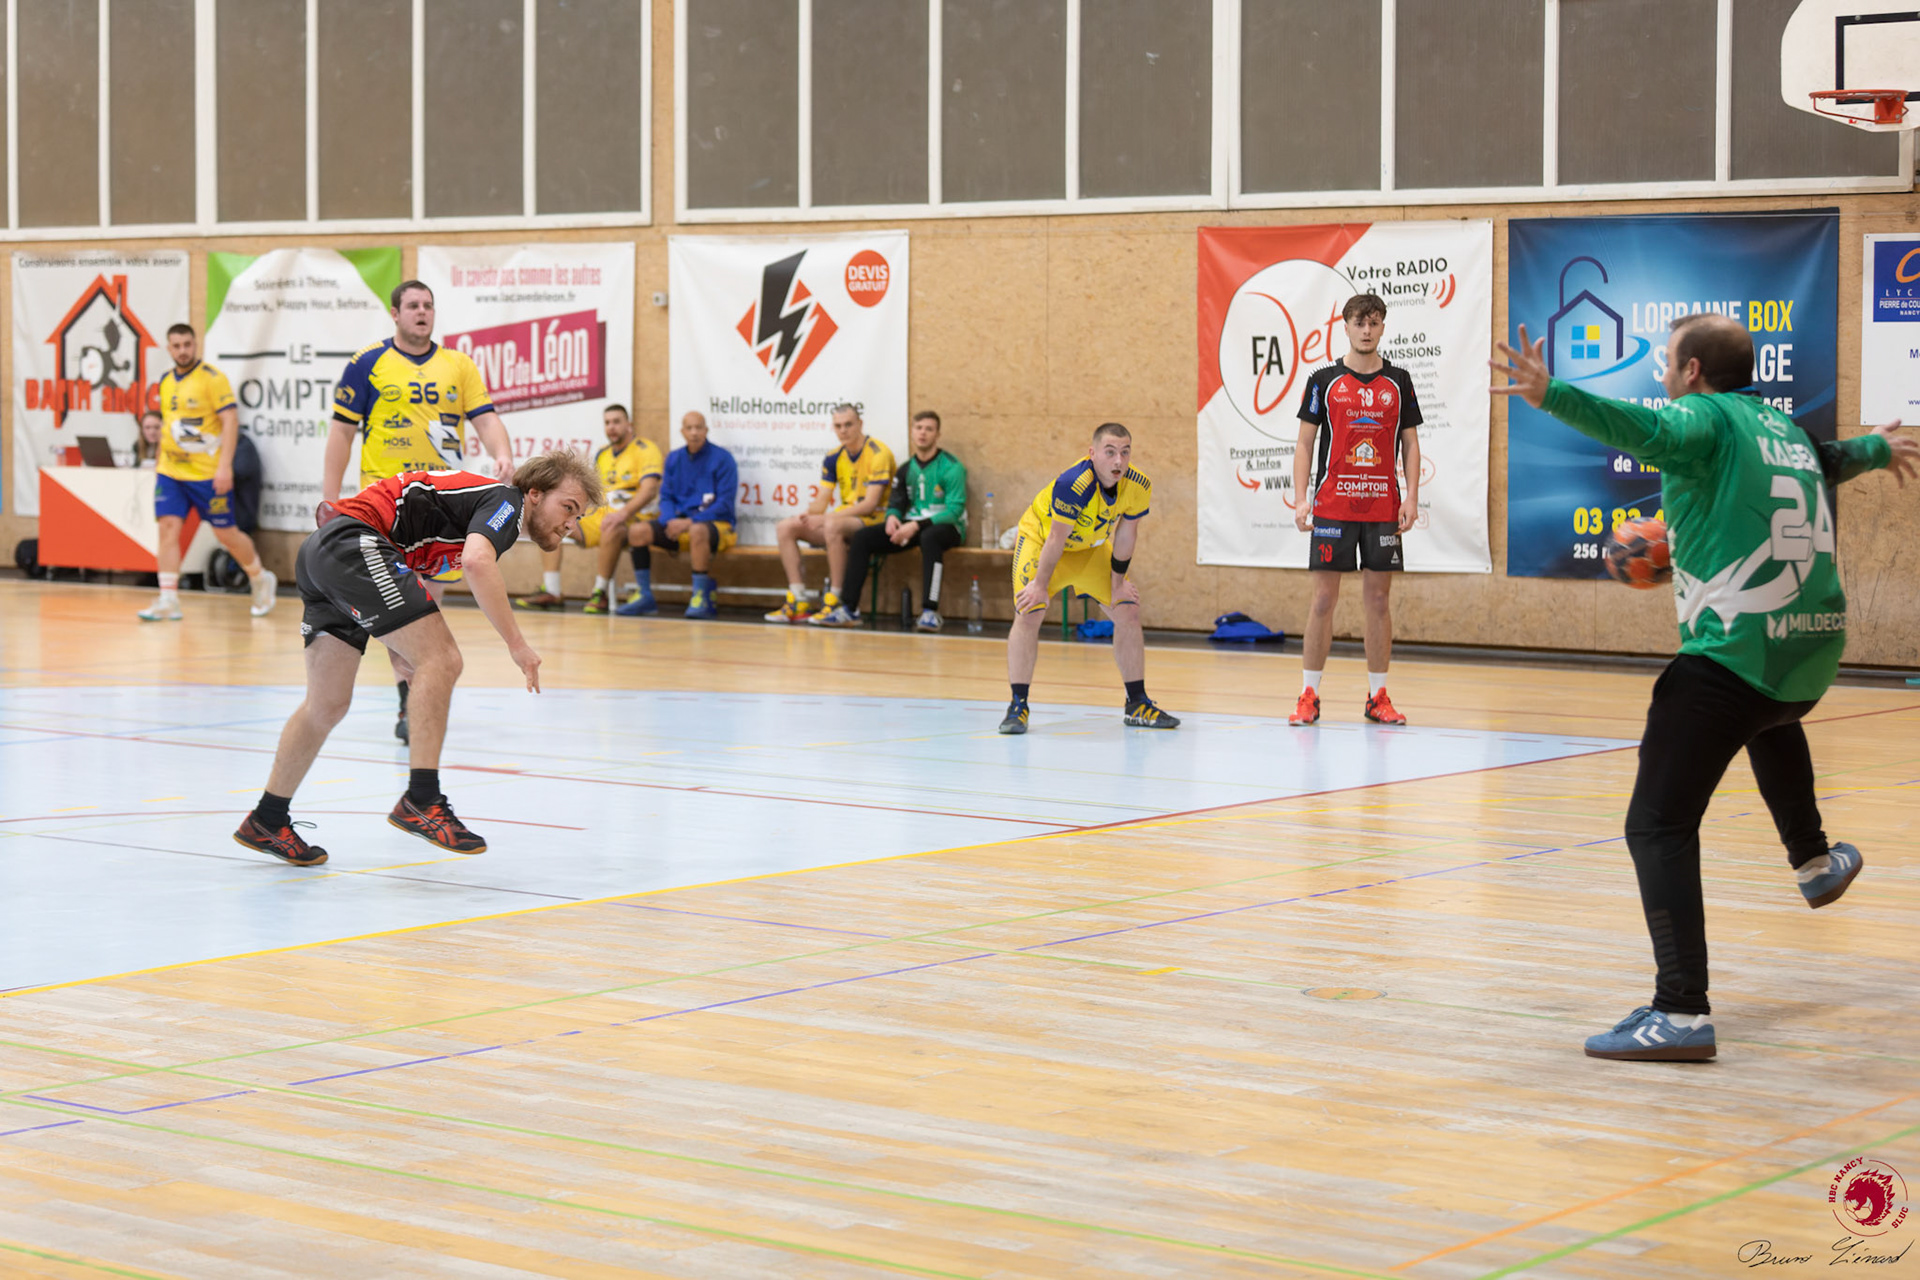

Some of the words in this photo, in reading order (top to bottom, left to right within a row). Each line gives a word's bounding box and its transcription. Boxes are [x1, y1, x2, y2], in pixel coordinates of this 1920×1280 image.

[848, 264, 888, 280] DEVIS
[1346, 265, 1391, 280] Votre
[1396, 257, 1448, 276] RADIO
[848, 280, 887, 291] GRATUIT
[1382, 281, 1429, 297] Nancy
[1879, 300, 1900, 309] PIERRE
[1748, 300, 1794, 332] BOX
[1412, 332, 1426, 344] 60
[289, 343, 313, 365] LE
[530, 318, 589, 384] Léon
[408, 382, 440, 405] 36
[1356, 387, 1374, 408] 18
[1346, 408, 1359, 418] Guy
[1360, 409, 1384, 418] Hoquet
[725, 419, 768, 430] solution
[771, 421, 797, 434] pour
[800, 420, 826, 431] votre
[513, 437, 536, 458] 17
[1230, 446, 1296, 460] Programmes
[1256, 458, 1282, 471] Infos
[1613, 454, 1632, 473] de
[740, 482, 763, 505] 21
[773, 483, 799, 507] 48
[1336, 481, 1389, 492] COMPTOIR
[1573, 506, 1604, 535] 03
[1769, 474, 1836, 565] 24
[1318, 543, 1333, 563] 18
[1573, 542, 1598, 559] 256
